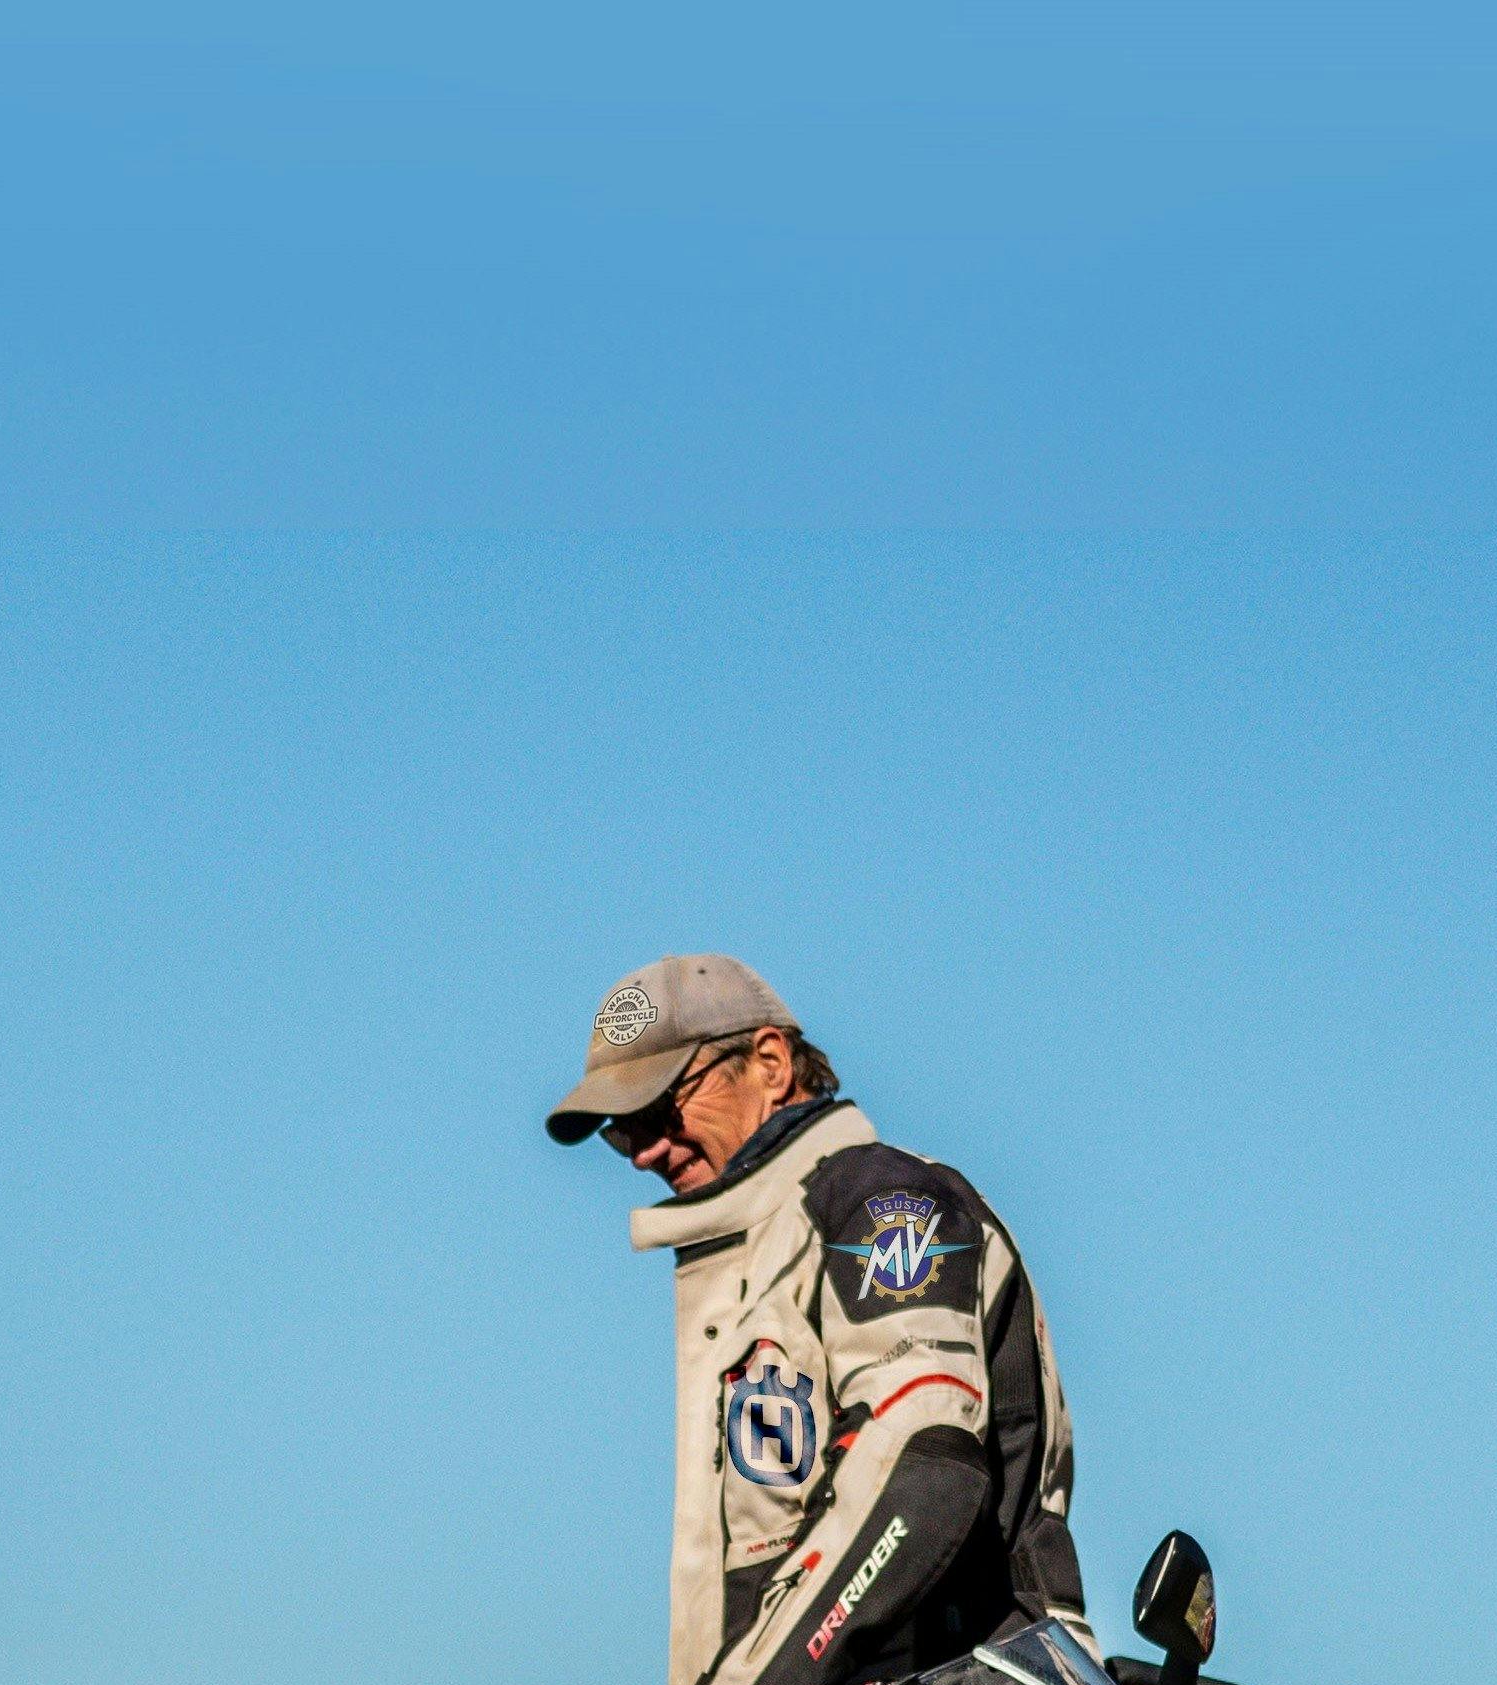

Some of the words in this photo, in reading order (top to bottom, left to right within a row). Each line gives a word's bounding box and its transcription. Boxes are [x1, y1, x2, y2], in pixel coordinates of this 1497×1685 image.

[608, 991, 646, 1012] WALCHA
[597, 1010, 655, 1026] MOTORCYCLE
[608, 1027, 638, 1042] RALLY
[872, 1200, 928, 1216] AGUSTA
[856, 1211, 944, 1300] MV
